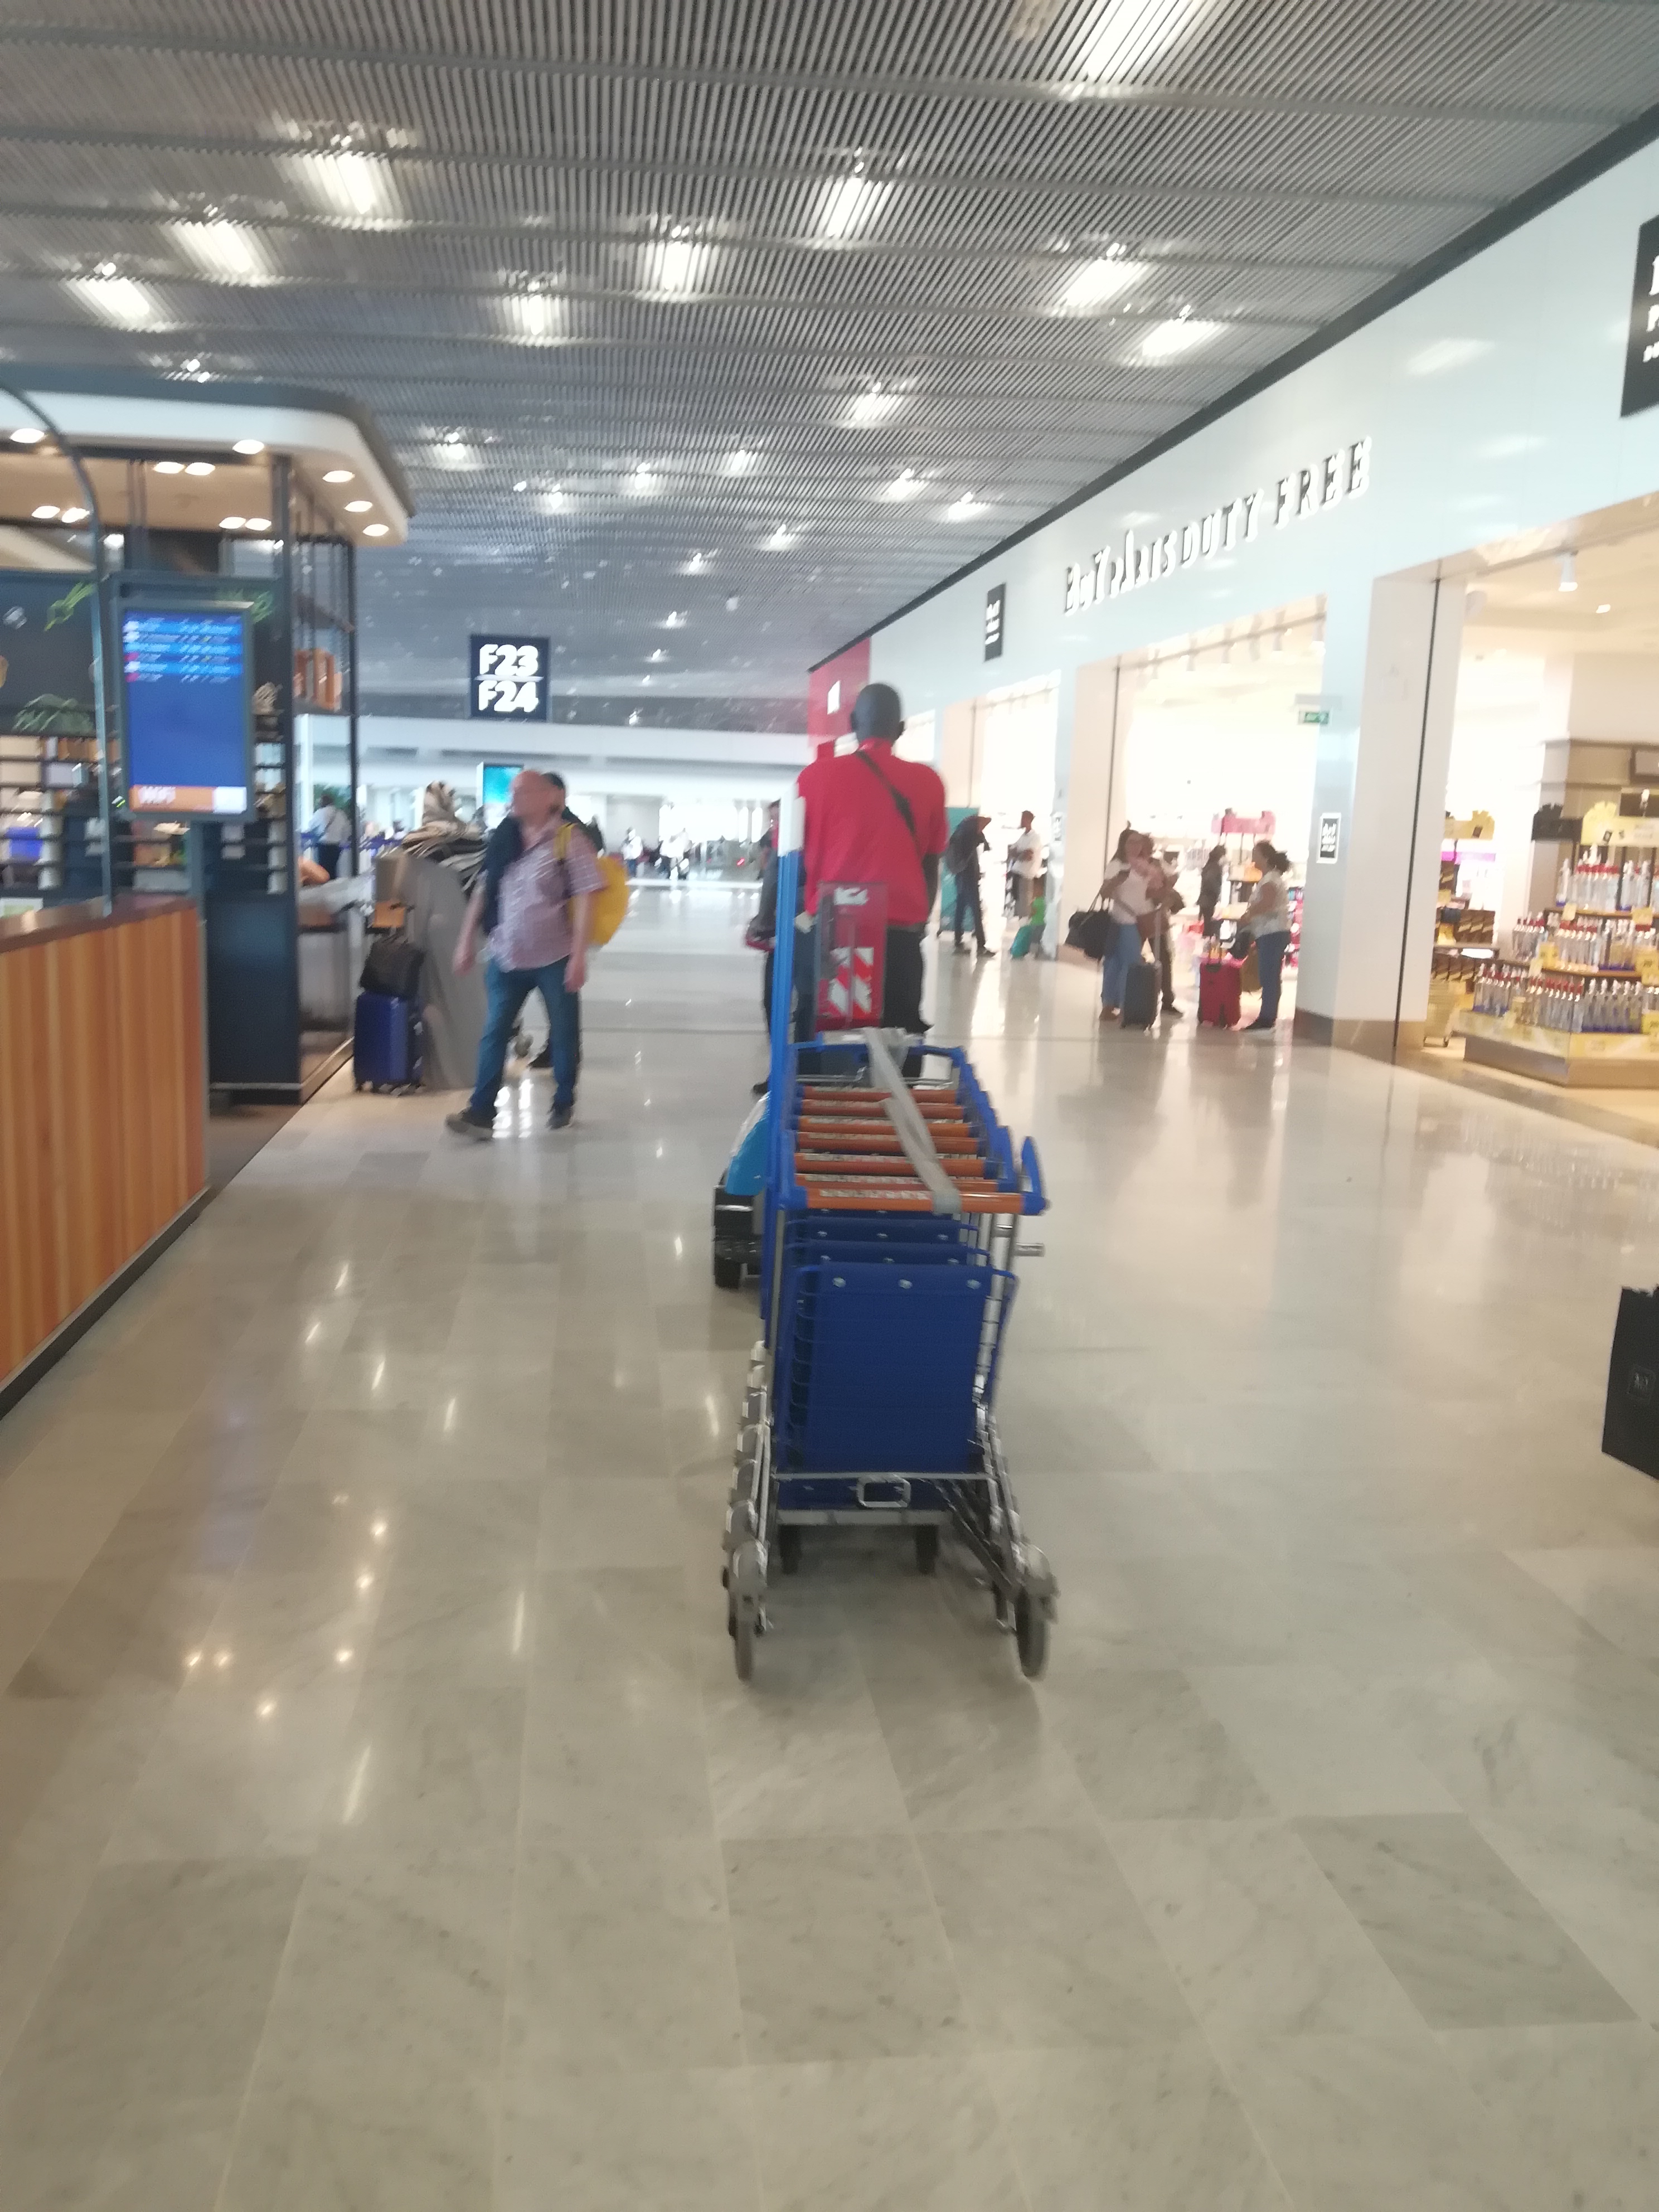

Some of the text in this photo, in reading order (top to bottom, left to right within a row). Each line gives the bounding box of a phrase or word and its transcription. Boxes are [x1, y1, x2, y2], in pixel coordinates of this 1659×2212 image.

[1180, 488, 1264, 569] DUTY
[1273, 436, 1372, 530] FREE
[479, 644, 539, 676] F23
[478, 680, 539, 713] F24
